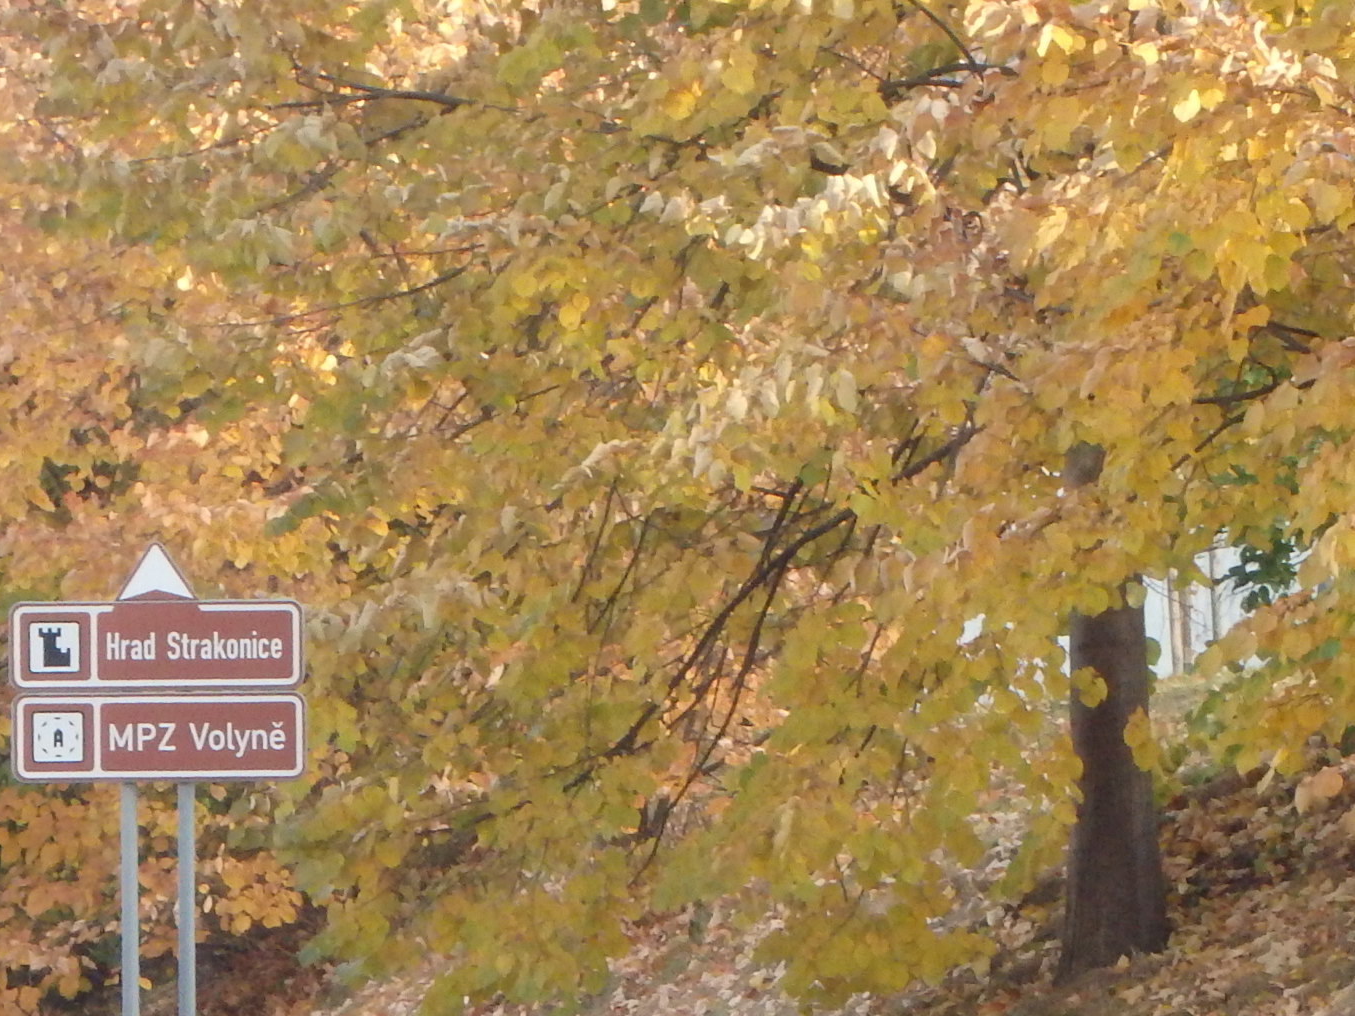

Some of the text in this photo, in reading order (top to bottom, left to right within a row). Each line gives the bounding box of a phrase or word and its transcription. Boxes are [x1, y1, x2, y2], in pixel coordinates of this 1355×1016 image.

[106, 630, 282, 660] Hrad Strakonice
[109, 721, 285, 757] MPZ Volyně
